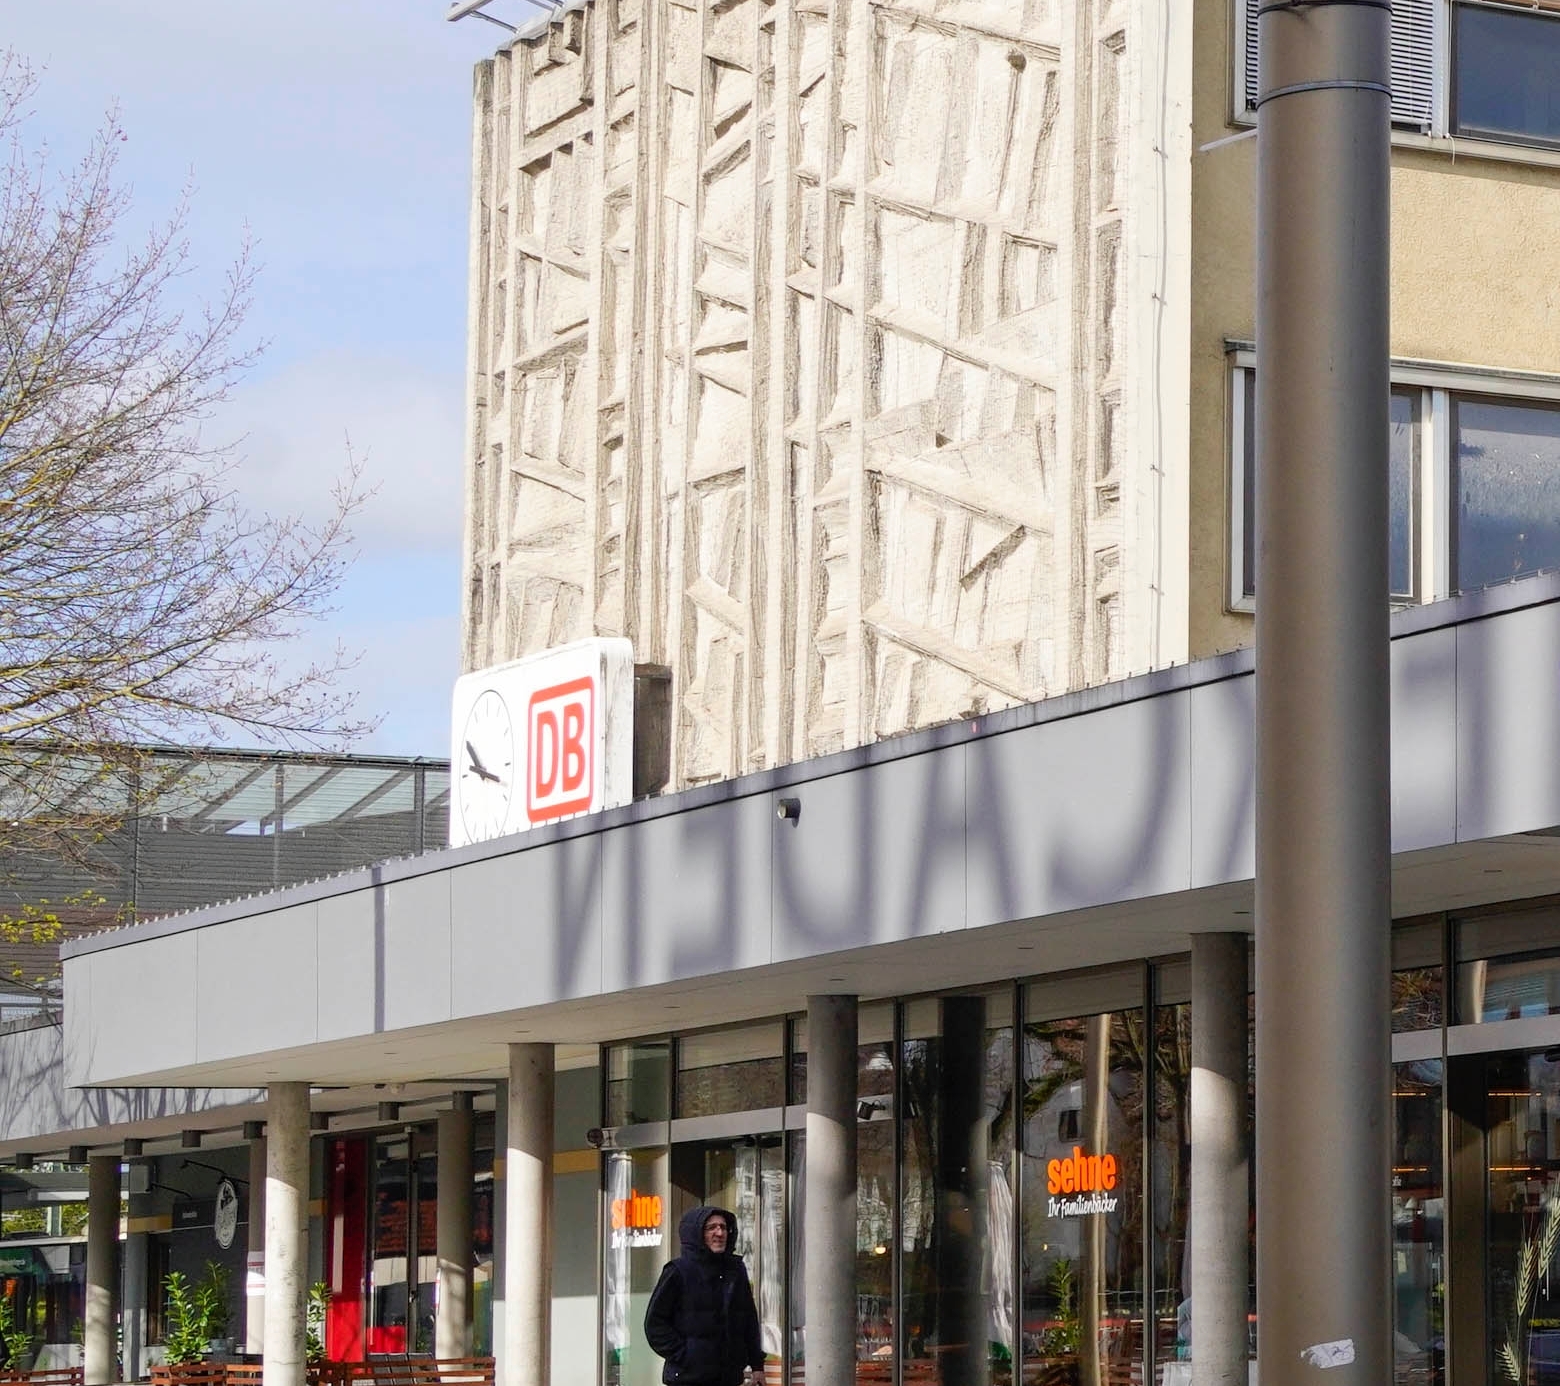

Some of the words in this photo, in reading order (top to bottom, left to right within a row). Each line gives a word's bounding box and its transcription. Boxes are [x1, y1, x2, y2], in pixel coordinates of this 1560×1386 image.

[536, 702, 586, 799] DB
[1047, 1146, 1117, 1195] sehne
[1047, 1196, 1061, 1218] Ihr
[1061, 1193, 1118, 1219] Familienbäcker
